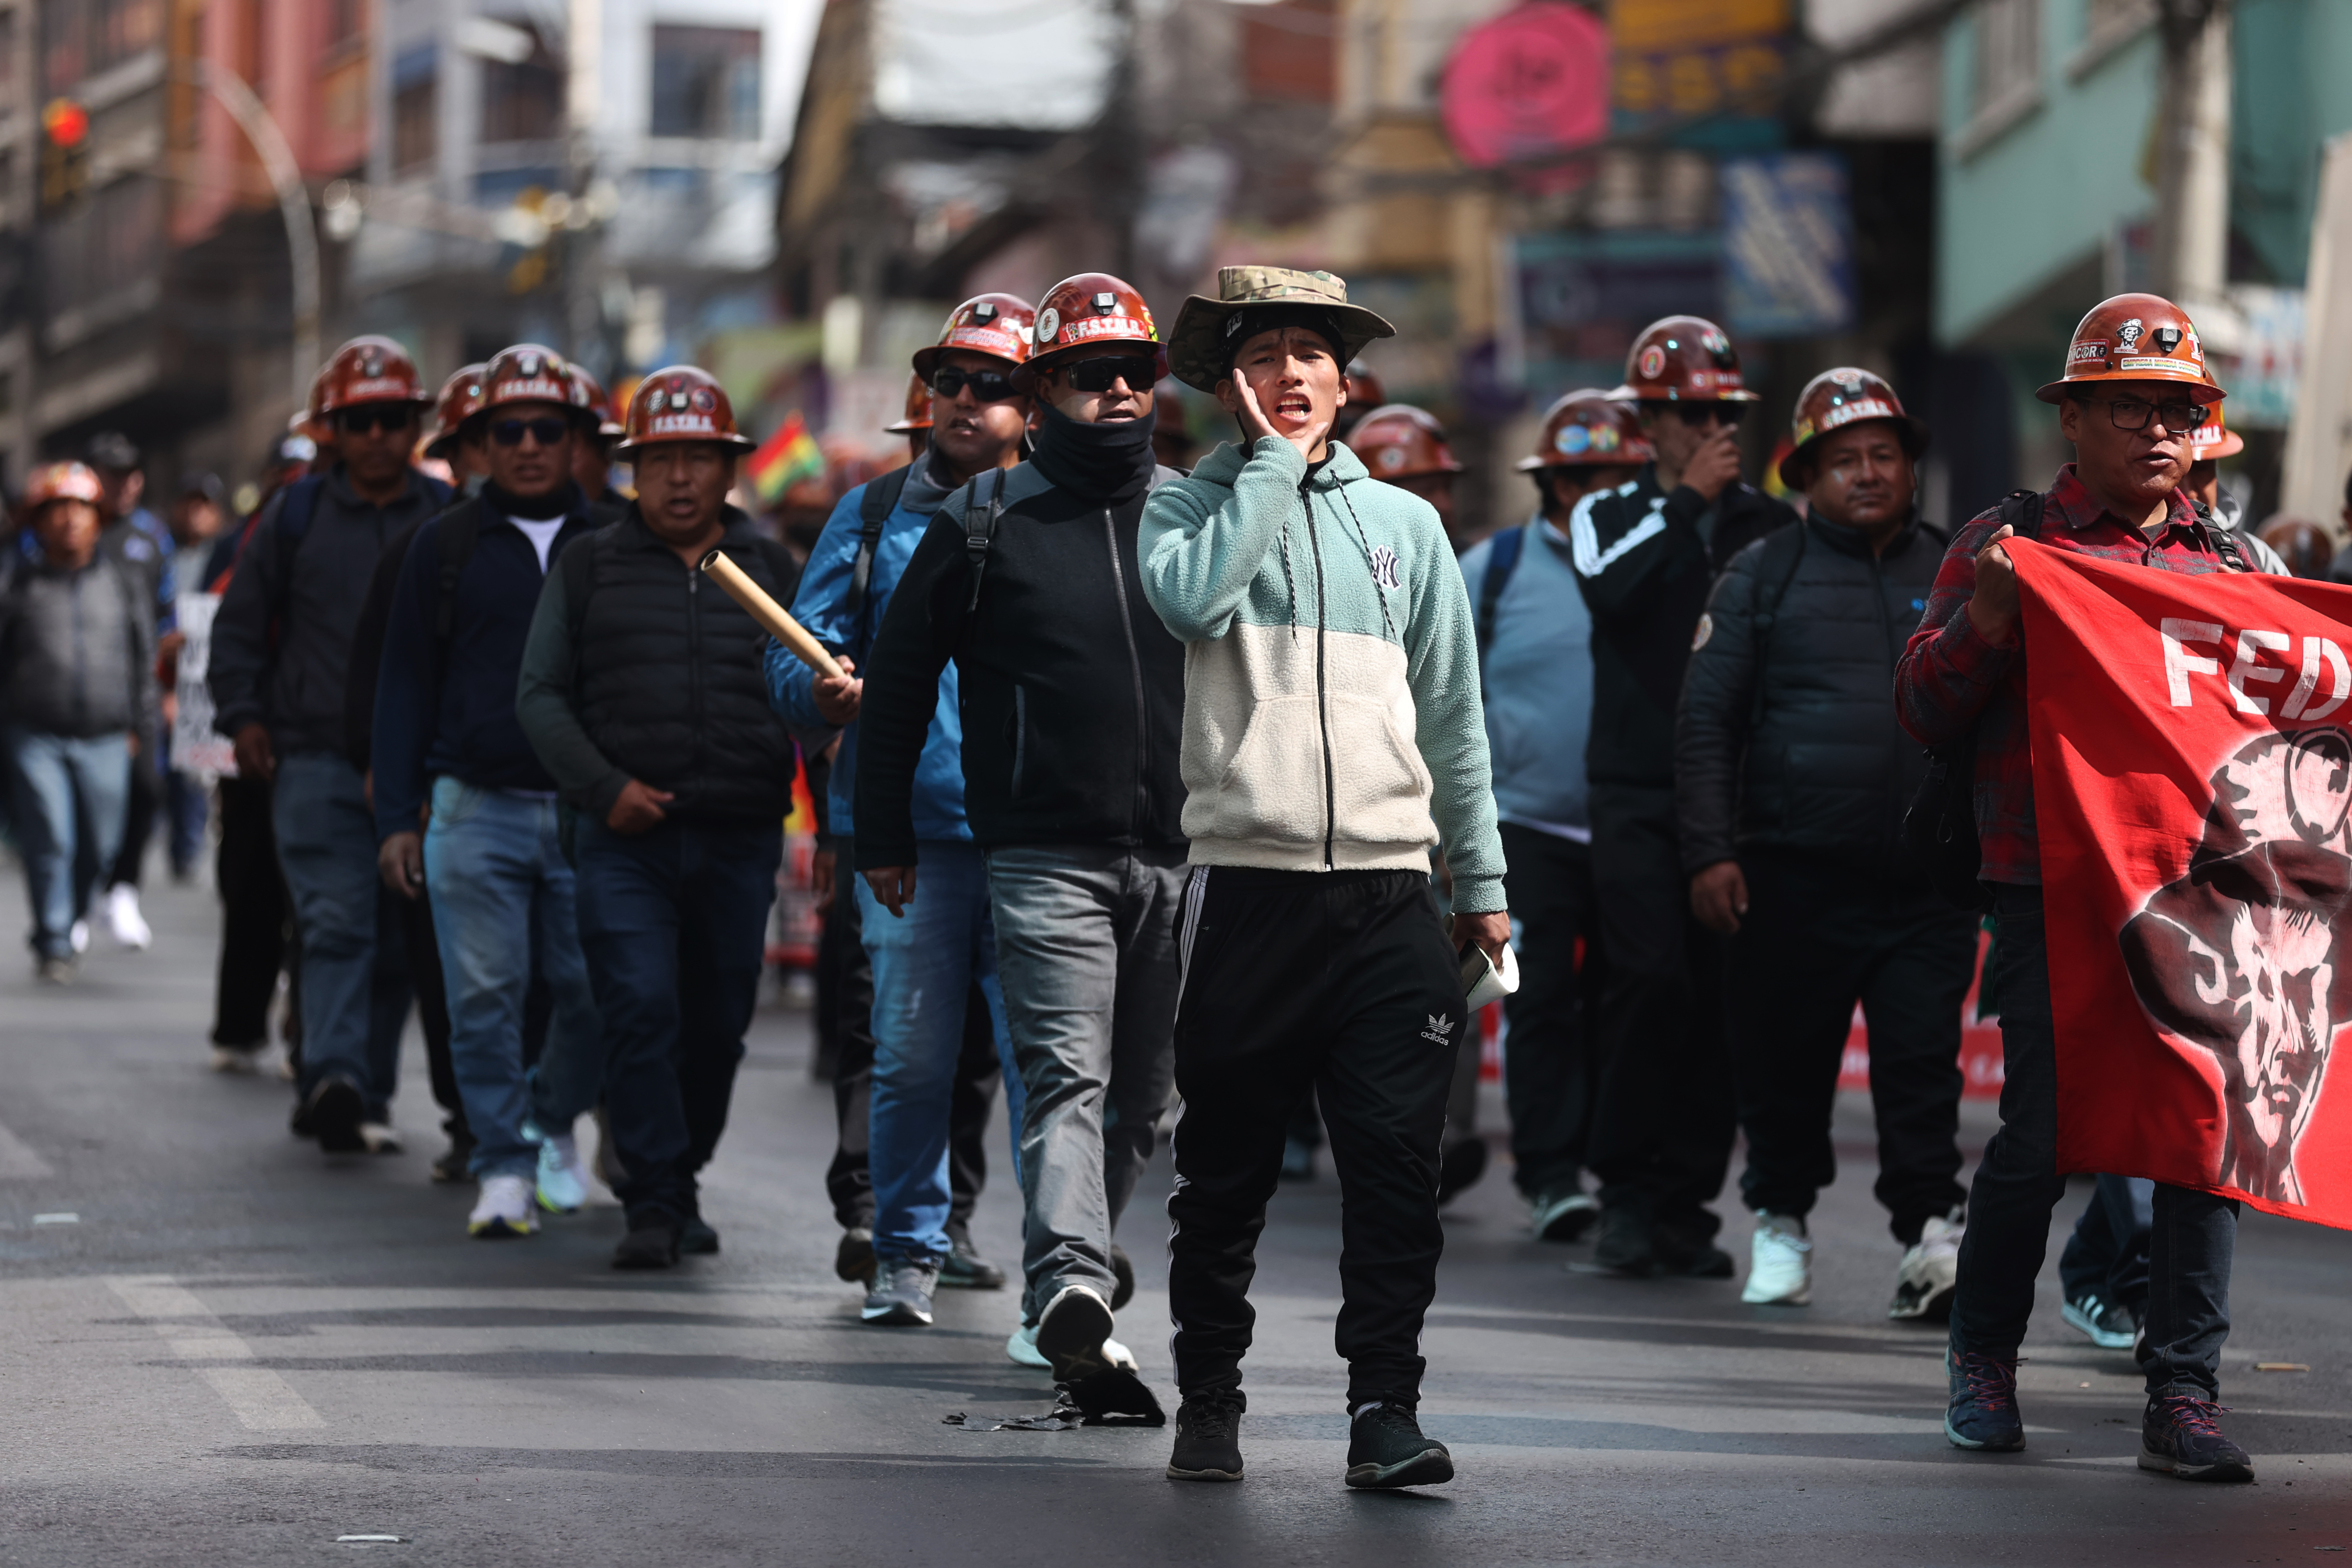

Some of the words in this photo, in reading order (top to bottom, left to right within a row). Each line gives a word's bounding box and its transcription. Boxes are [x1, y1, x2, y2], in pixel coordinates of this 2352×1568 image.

[1078, 318, 1142, 337] F.S.T.M.B.
[2123, 358, 2153, 367] EMPRESA
[2154, 359, 2177, 368] MINERA
[1421, 1032, 1449, 1045] adidas
